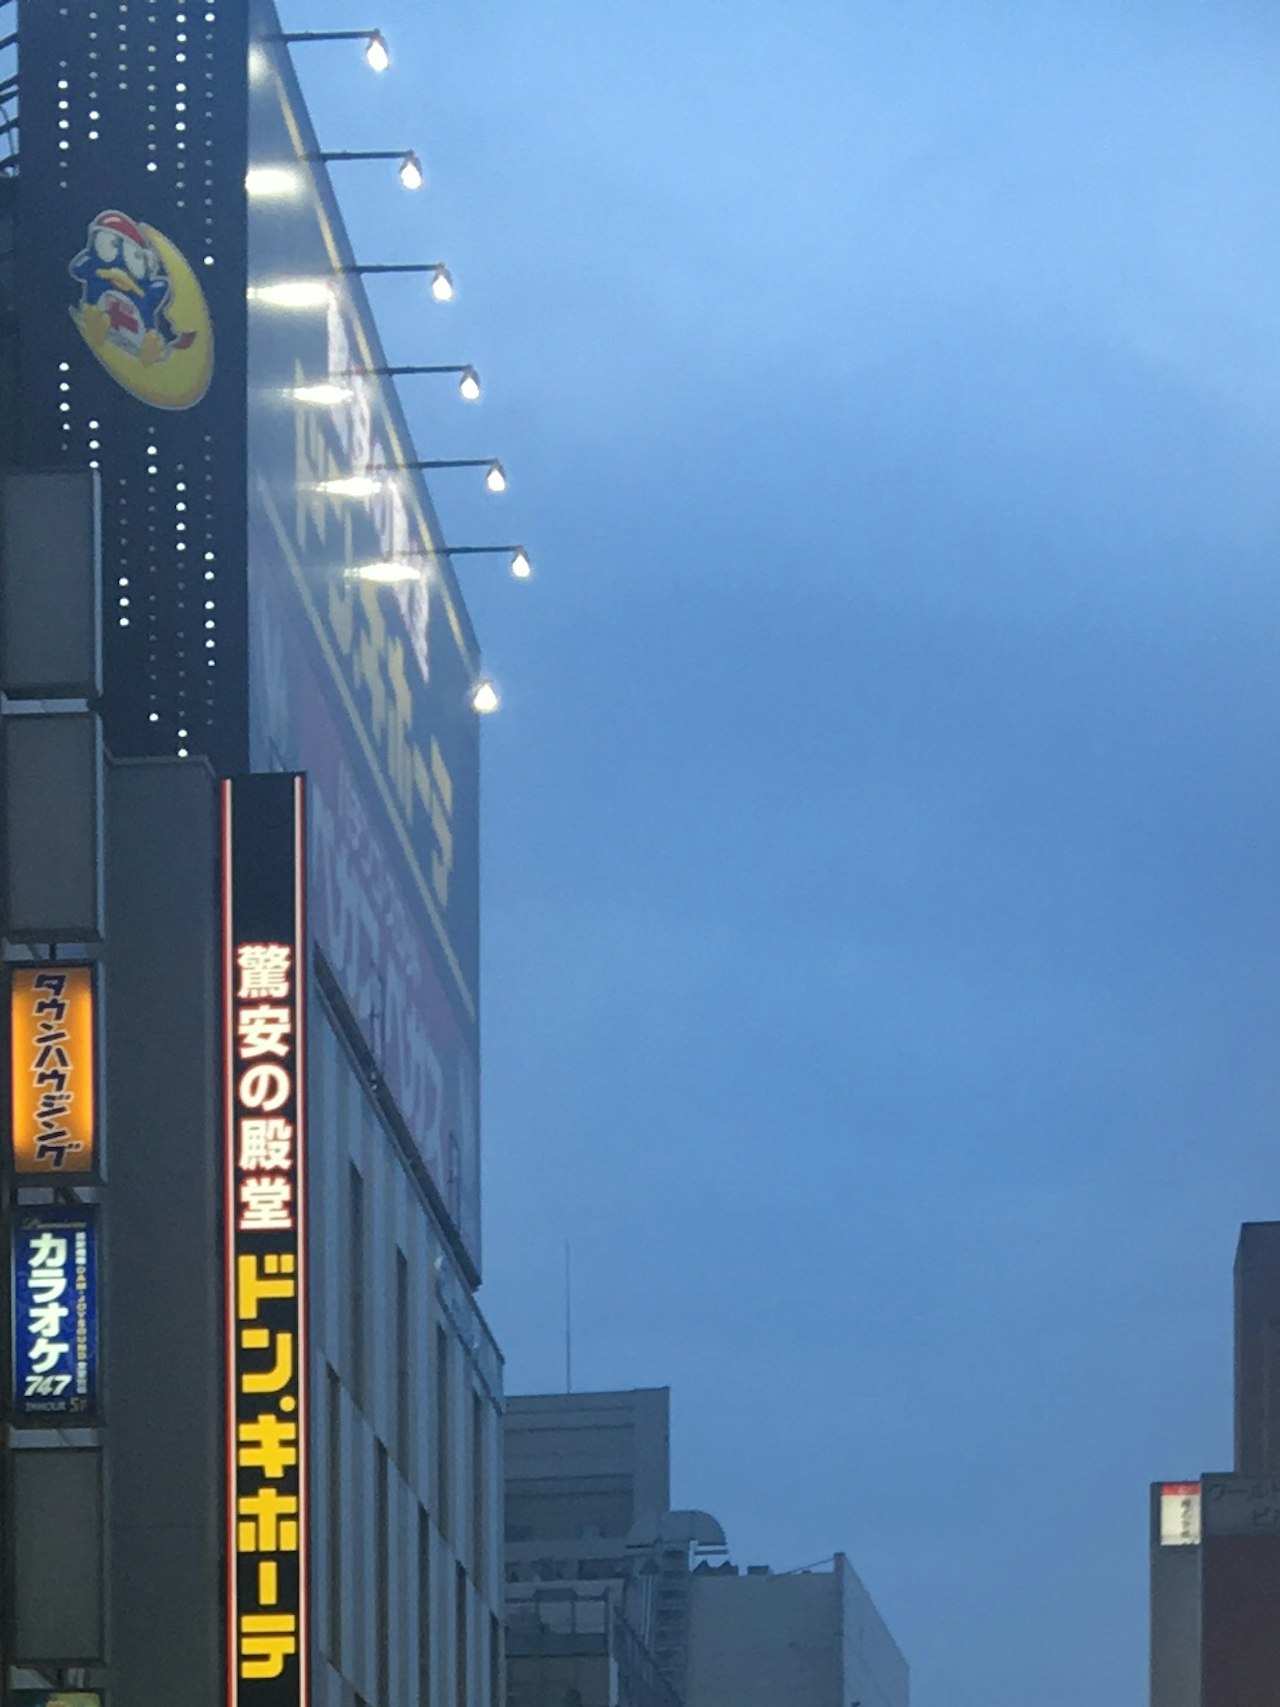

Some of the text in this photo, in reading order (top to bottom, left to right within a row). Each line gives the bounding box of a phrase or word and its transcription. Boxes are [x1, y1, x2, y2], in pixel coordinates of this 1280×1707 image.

[32, 972, 81, 1169] タウンハウジング
[237, 945, 294, 1231] 驚安の殿堂
[23, 1373, 71, 1398] 747
[27, 1232, 71, 1373] カラオケ
[238, 1254, 298, 1681] ドン・キホーテ
